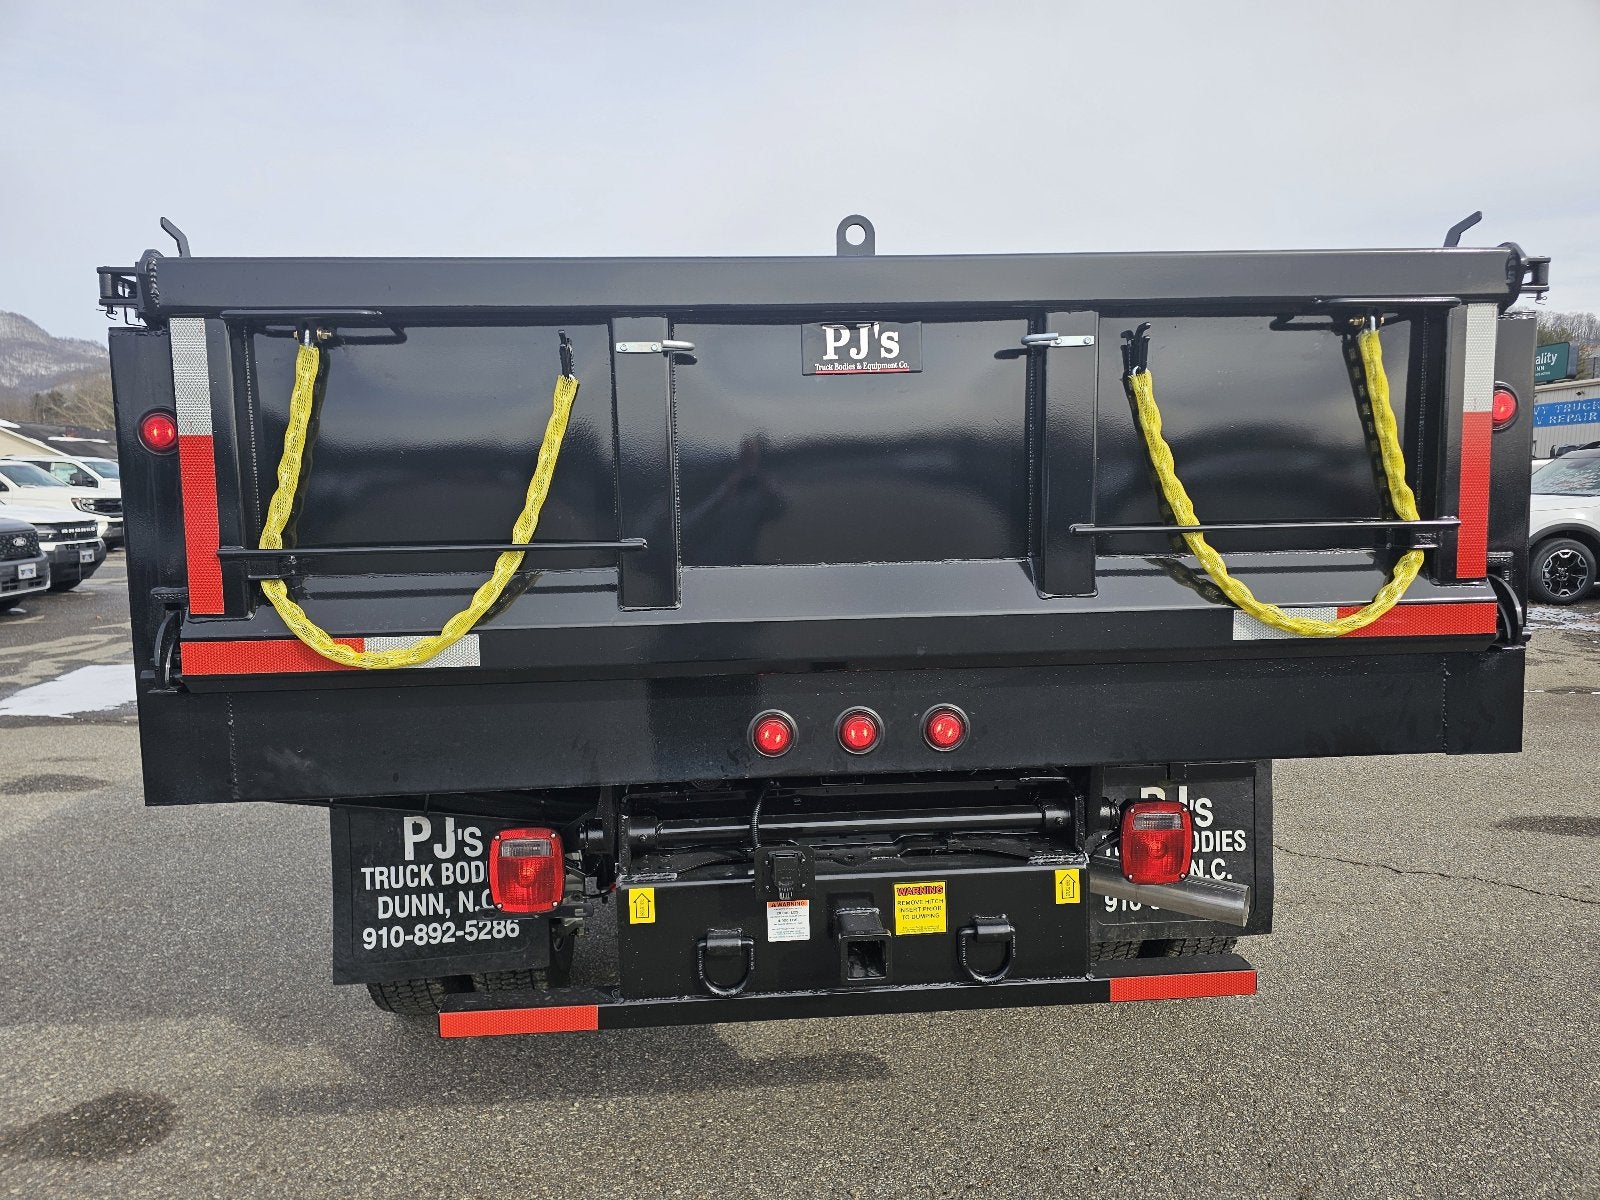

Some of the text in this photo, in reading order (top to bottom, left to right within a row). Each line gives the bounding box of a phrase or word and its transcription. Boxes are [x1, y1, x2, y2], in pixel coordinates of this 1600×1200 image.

[822, 322, 900, 360] PJ's
[815, 361, 910, 371] Truck Bodies & Equipment Co.
[1549, 412, 1598, 424] REPAIR
[361, 864, 434, 890] TRUCK
[896, 885, 943, 896] WARNING
[377, 892, 450, 919] DUNN,
[362, 920, 520, 950] 910-892-5286
